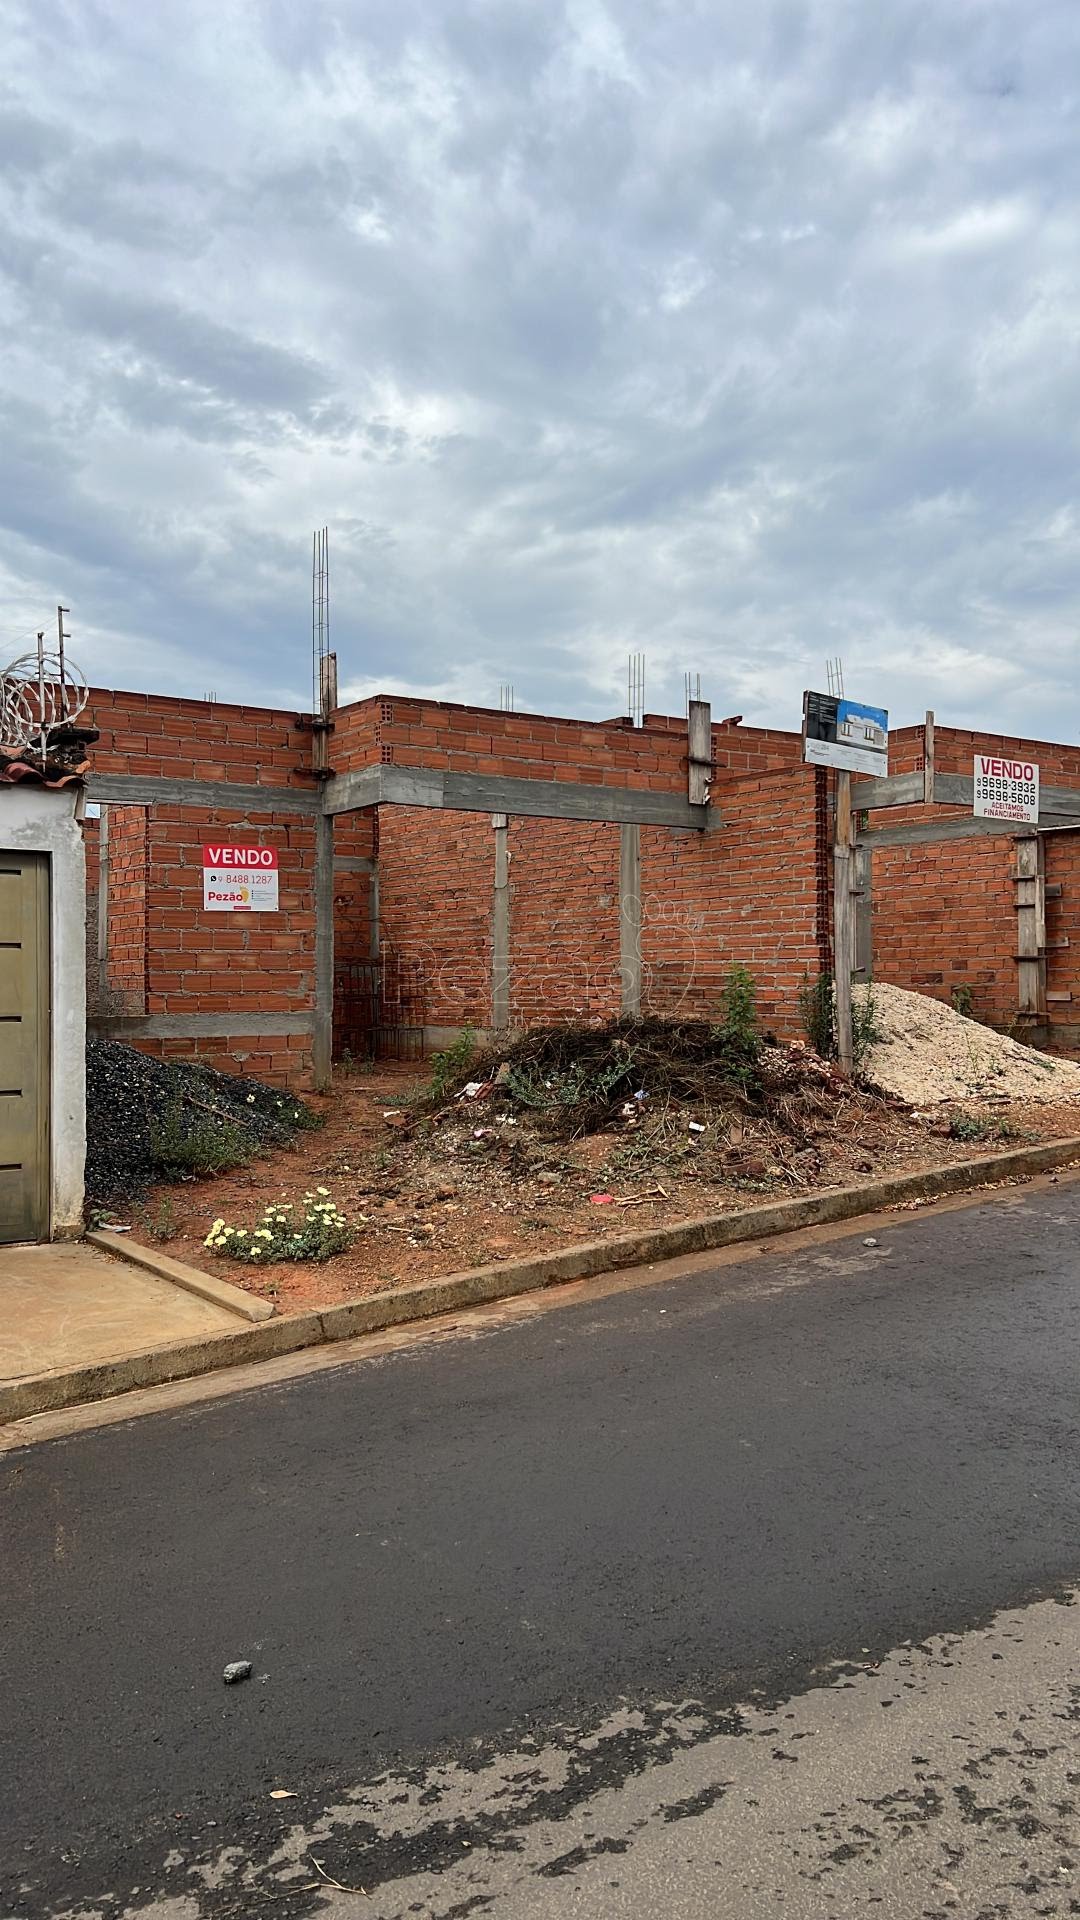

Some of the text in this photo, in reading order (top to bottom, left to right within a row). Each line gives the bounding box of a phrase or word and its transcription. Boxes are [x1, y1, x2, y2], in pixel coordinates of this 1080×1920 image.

[981, 758, 1034, 781] VENDO
[991, 802, 1024, 812] ACEITAMOS
[983, 808, 1031, 820] FINANCIAMENTO
[208, 848, 273, 866] VENDO
[208, 891, 243, 901] Pezão
